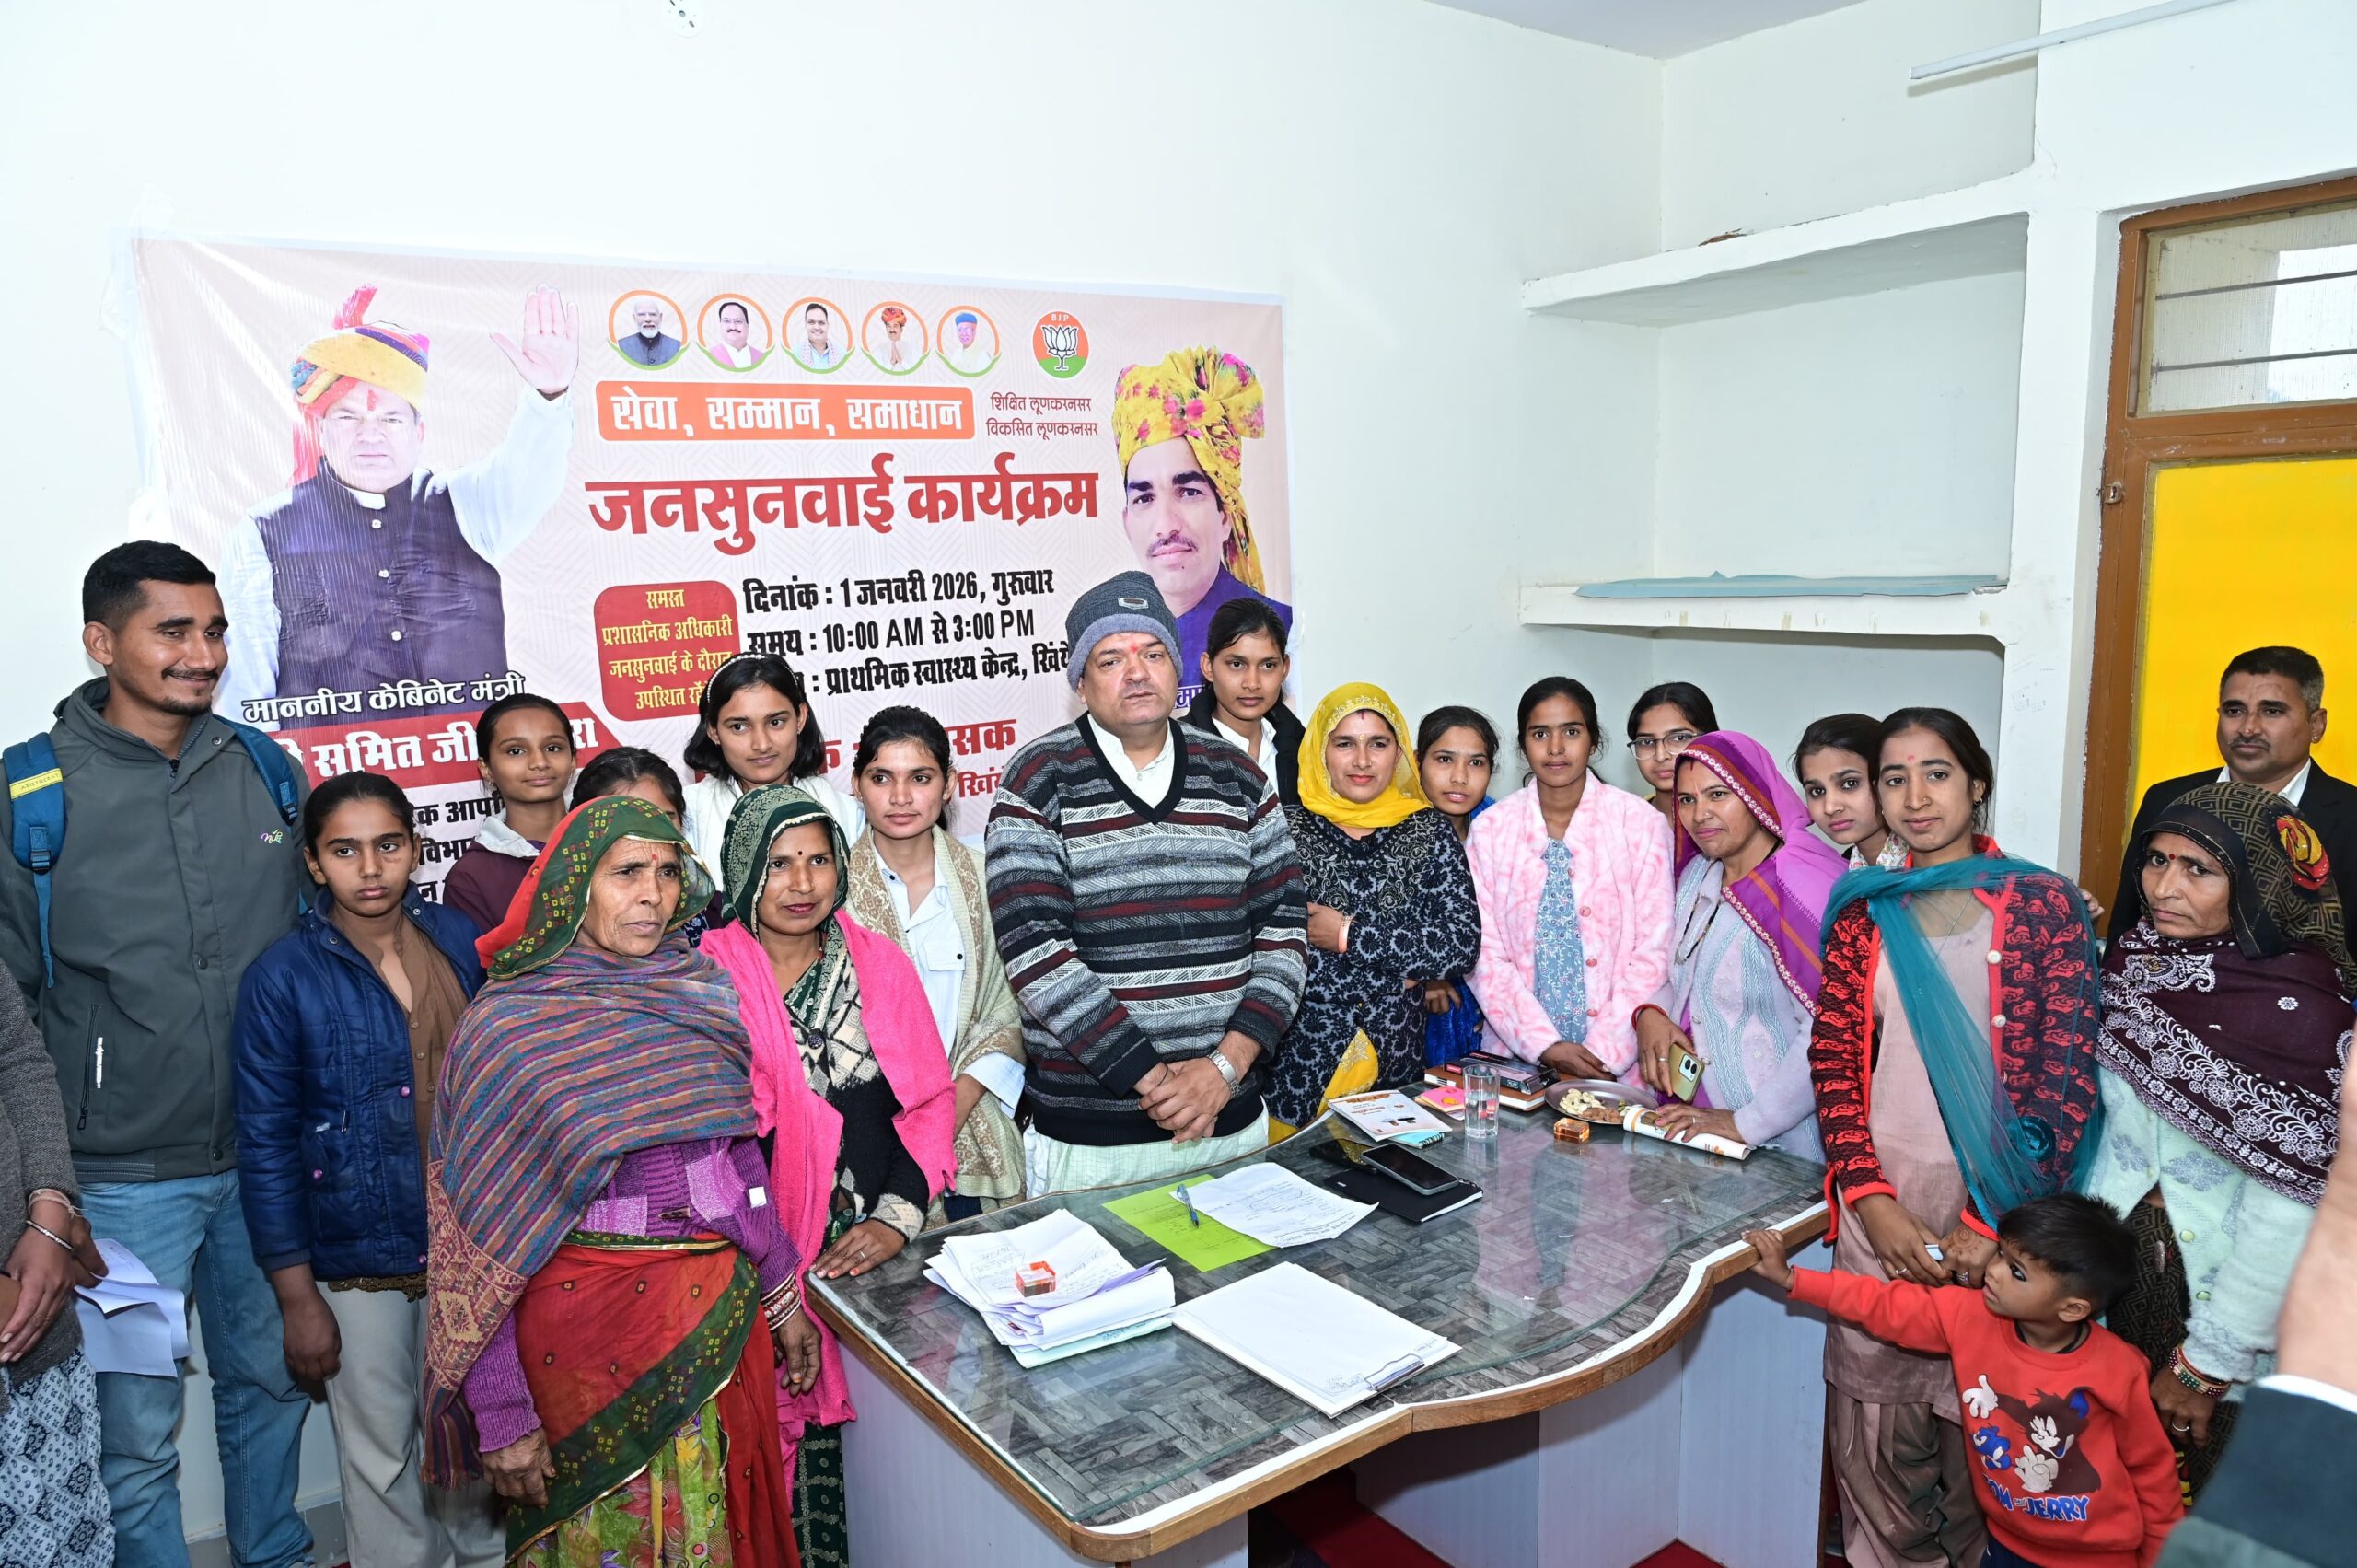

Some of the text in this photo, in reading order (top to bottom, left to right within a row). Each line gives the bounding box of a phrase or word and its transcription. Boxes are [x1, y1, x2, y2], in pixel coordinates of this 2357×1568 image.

[1051, 313, 1069, 322] BJP
[610, 385, 963, 437] सेवा, सम्मान, समाधान
[990, 391, 1092, 415] शिक्षित लूणकरनसर
[986, 417, 1098, 441] विकसित लूणकरनसर
[585, 451, 1099, 555] जनसुनवाई कार्यक्रम
[646, 589, 685, 609] समस्त
[742, 575, 819, 614] दिनांक
[840, 578, 851, 607] 1
[854, 569, 928, 606] जनवरी
[932, 571, 986, 603] 2026,
[602, 614, 733, 646] प्रशासनिक अधिकारी
[747, 630, 804, 656] समय
[822, 621, 879, 653] 10:00
[886, 616, 923, 648] AM
[930, 611, 949, 644] से
[953, 612, 994, 642] 3:00
[1000, 608, 1034, 638] PM
[609, 650, 678, 683] जनसुनवाई
[680, 649, 694, 672] के
[825, 656, 910, 696] प्राथमिक
[912, 656, 978, 686] स्वास्थ्य
[981, 646, 1028, 681] केन्द्र,
[242, 672, 525, 722] माननीय केबिनेट मंत्री
[635, 681, 708, 710] उपस्थित रहें
[427, 721, 478, 762] जी
[2023, 1495, 2090, 1521] JERRY
